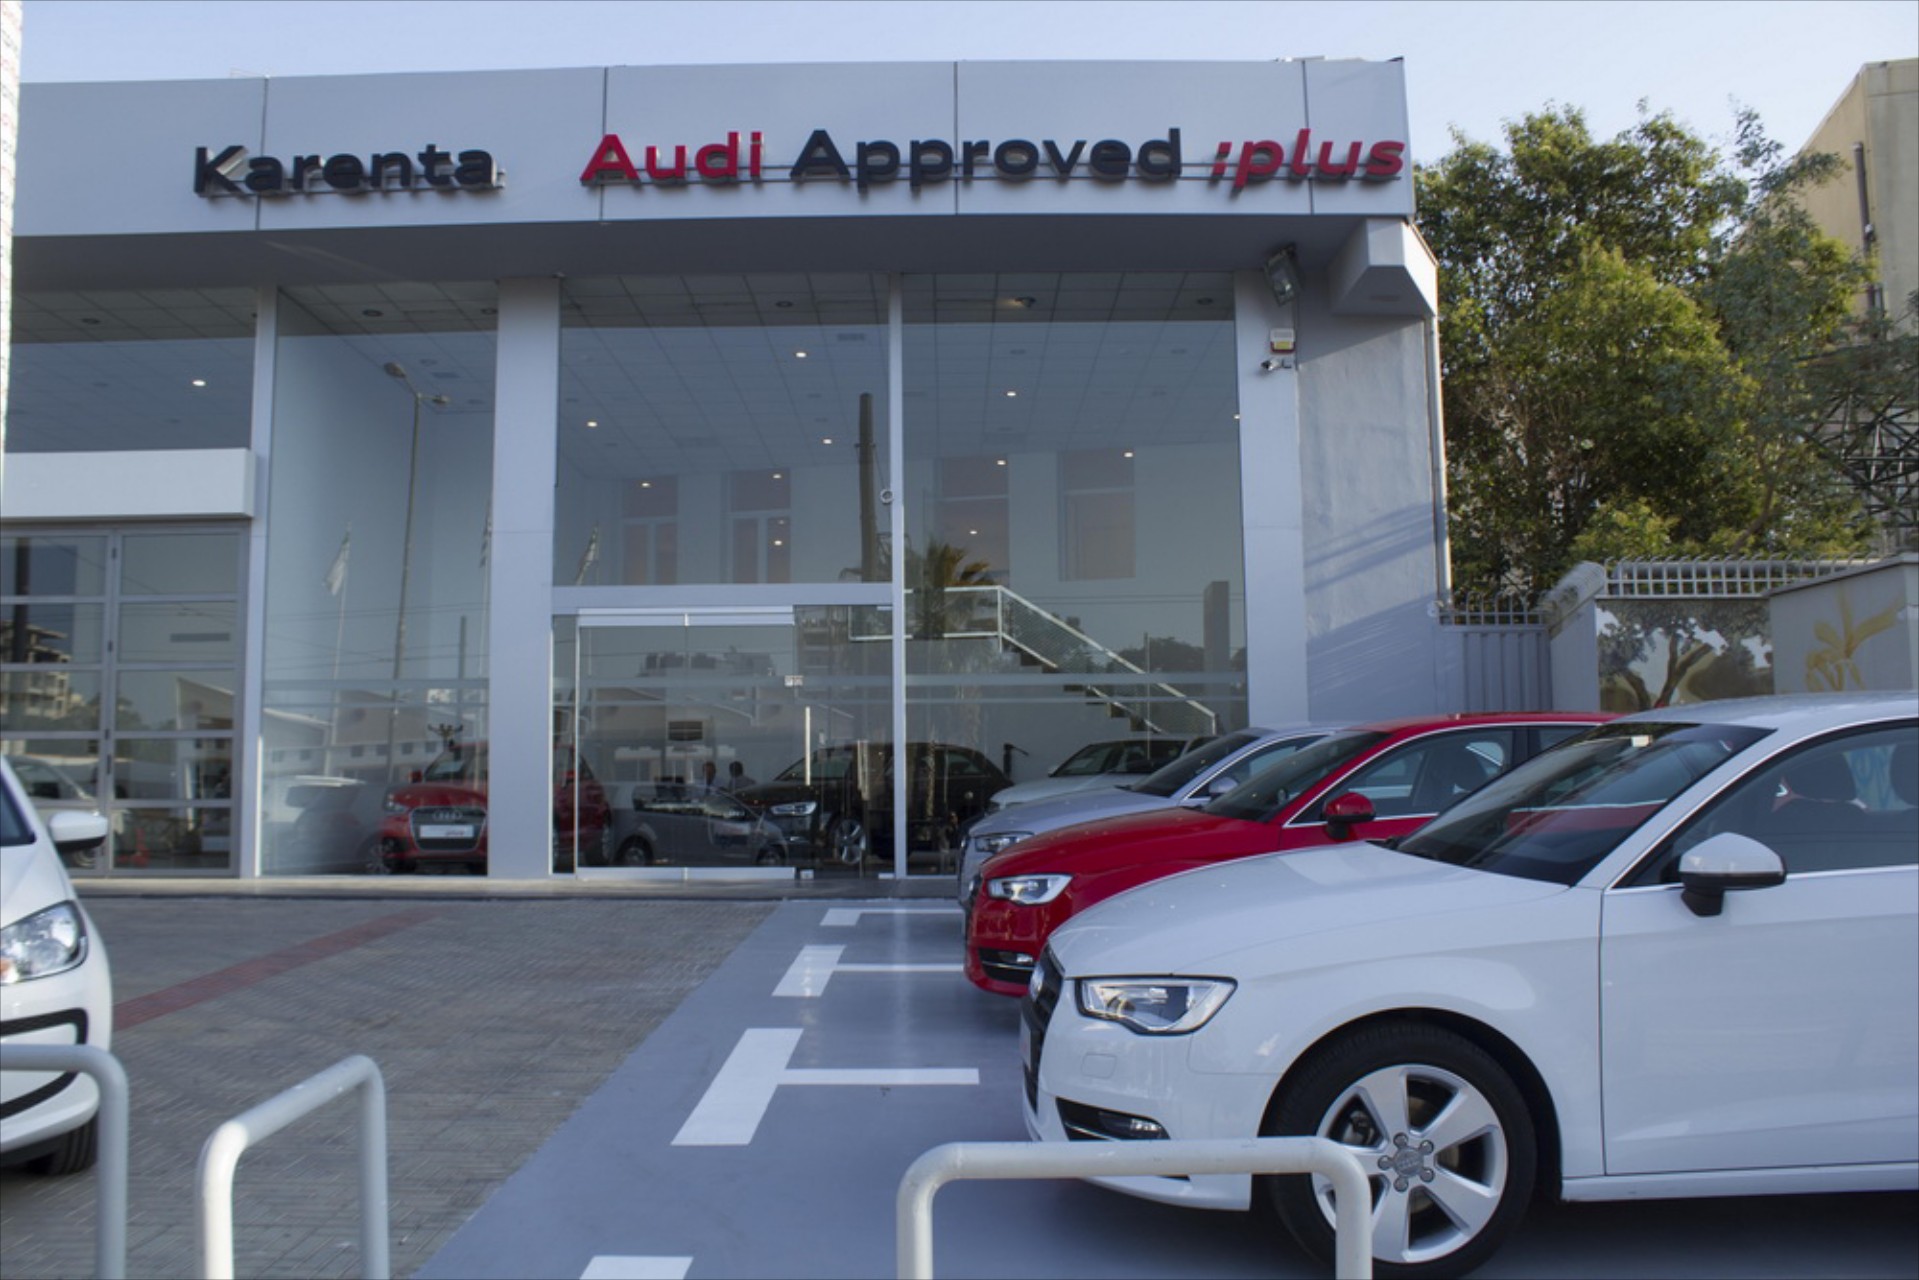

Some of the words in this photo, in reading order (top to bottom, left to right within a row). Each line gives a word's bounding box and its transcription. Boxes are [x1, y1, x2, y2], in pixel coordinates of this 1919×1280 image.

[194, 144, 500, 198] Karenta
[580, 131, 764, 184] Audi
[790, 128, 1183, 191] Approved
